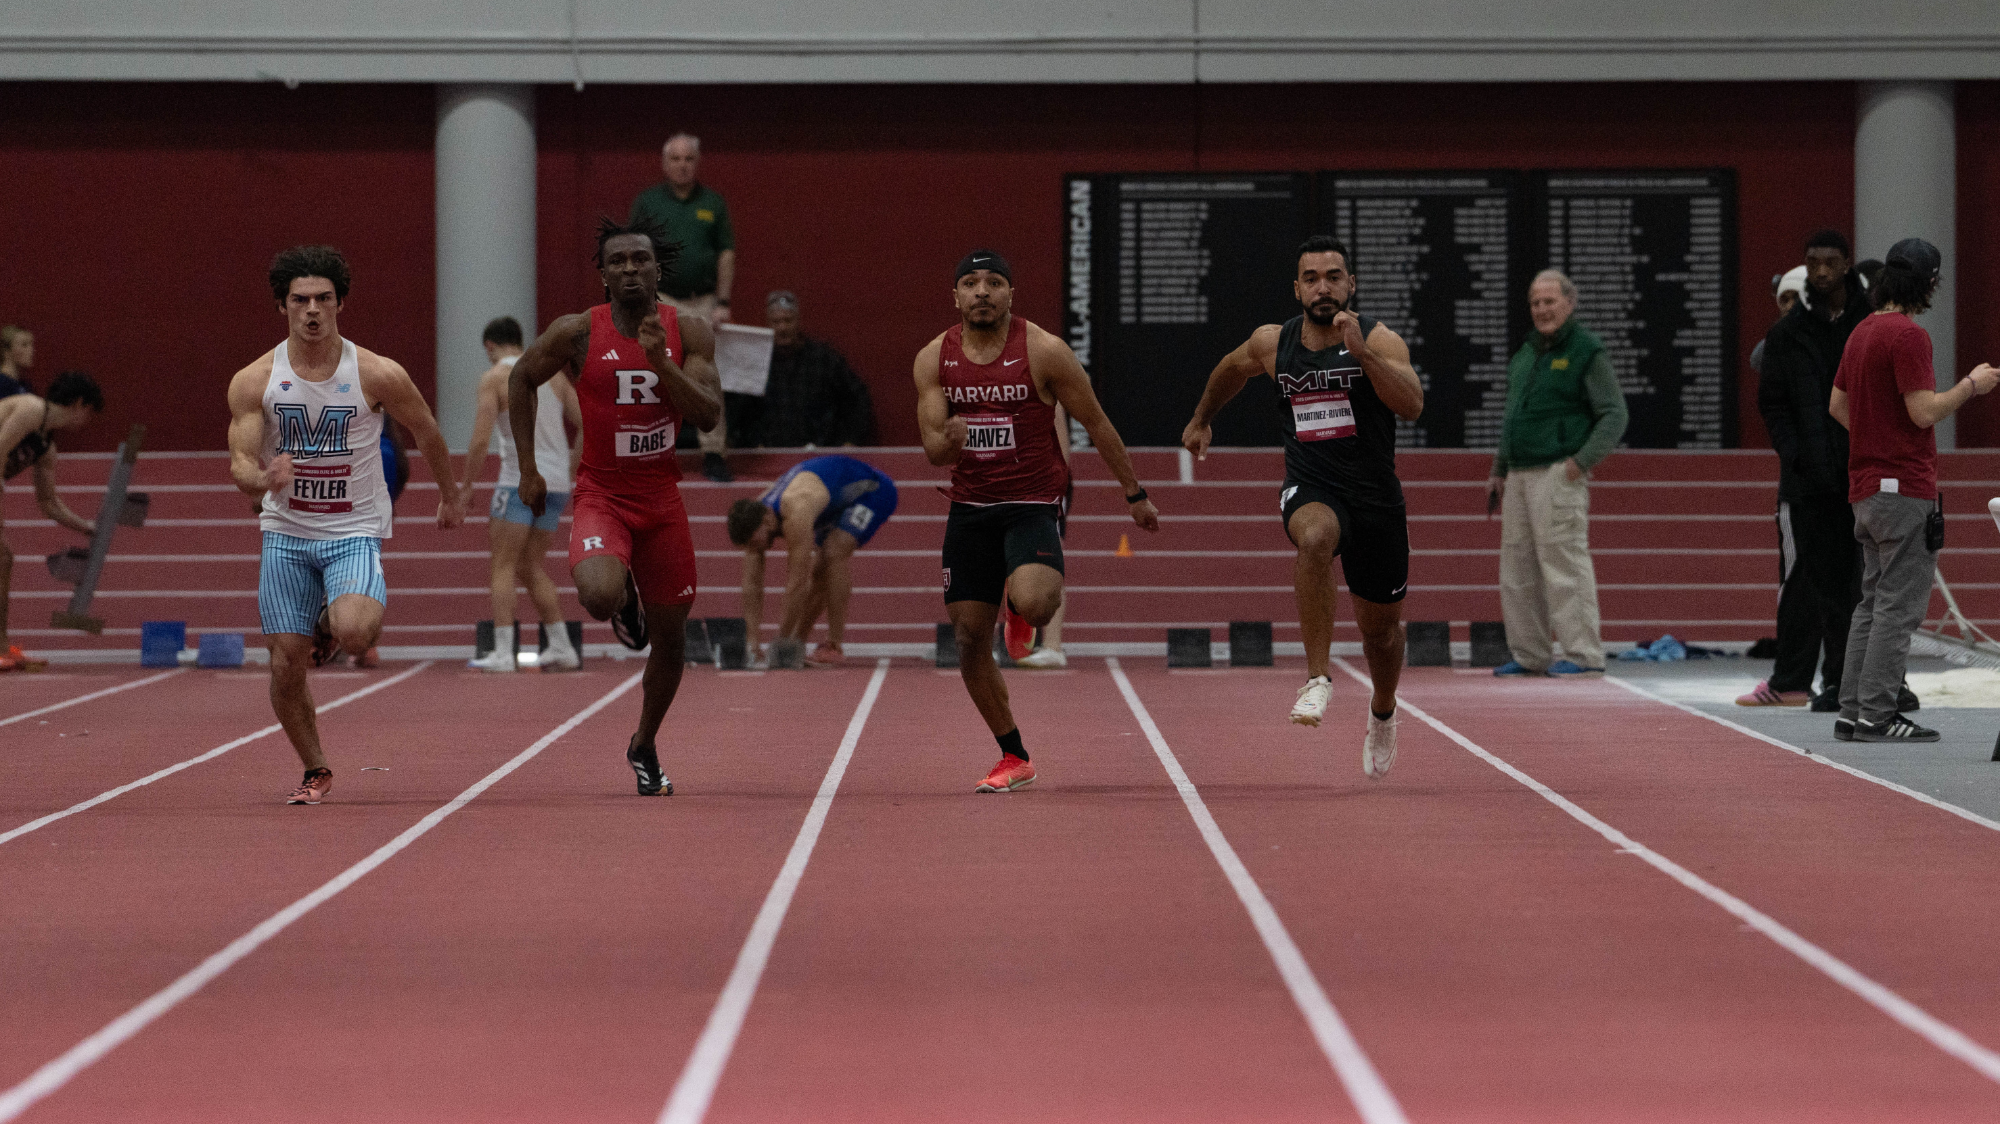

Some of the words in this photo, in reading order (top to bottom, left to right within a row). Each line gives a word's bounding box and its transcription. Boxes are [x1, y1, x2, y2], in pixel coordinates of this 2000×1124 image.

[1070, 181, 1092, 364] ALL-AMERICAN
[615, 369, 661, 405] R
[1278, 367, 1363, 392] MIT
[943, 384, 1028, 403] HARVARD
[274, 403, 357, 460] M
[630, 429, 666, 453] BABE
[294, 479, 347, 500] FEYLER
[582, 536, 604, 552] R
